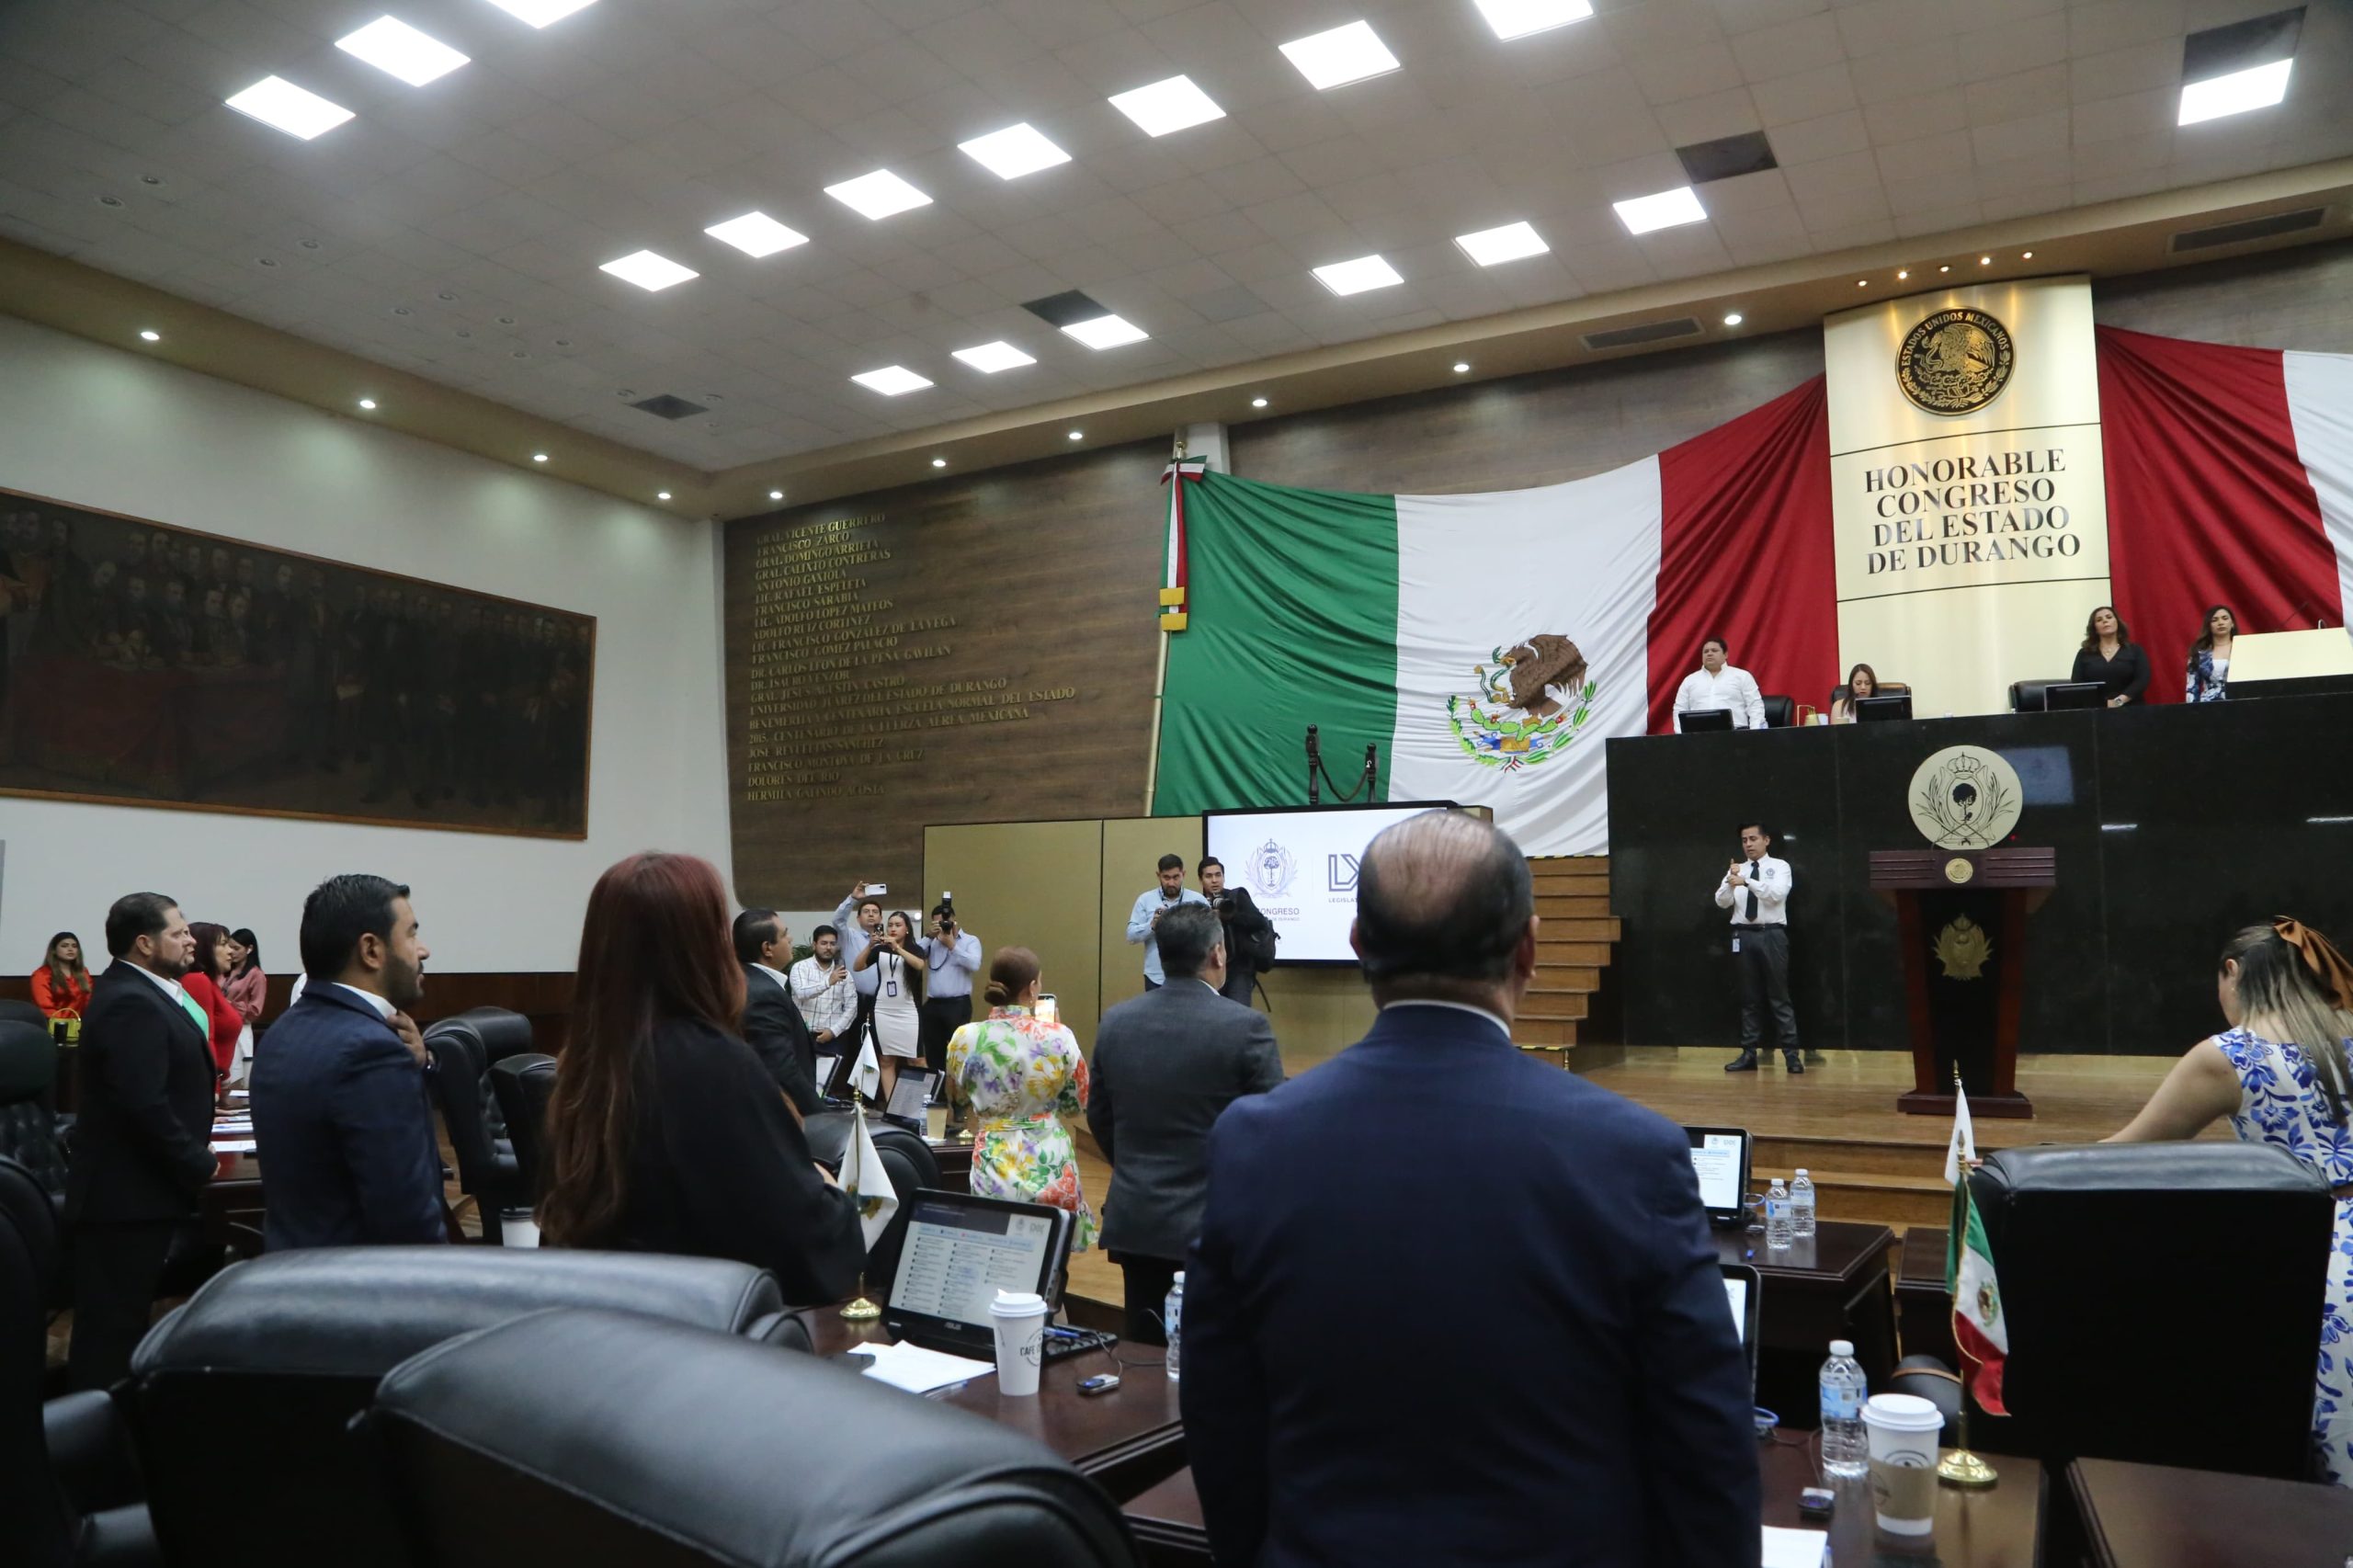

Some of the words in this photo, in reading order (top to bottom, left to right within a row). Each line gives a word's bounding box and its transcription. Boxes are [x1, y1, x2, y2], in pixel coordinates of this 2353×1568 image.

[1902, 327, 1927, 367] ESTADOS
[1925, 312, 1963, 331] UNIDOS
[1964, 312, 2009, 350] MEXICANOS
[1864, 449, 2066, 494] HONORABLE
[1876, 478, 2055, 518] CONGRESO
[1872, 519, 1934, 547] DEL
[1941, 505, 2070, 540] ESTADO
[1867, 549, 1907, 575] DE
[1917, 533, 2081, 569] DURANGO
[1259, 907, 1300, 915] ONGRESO
